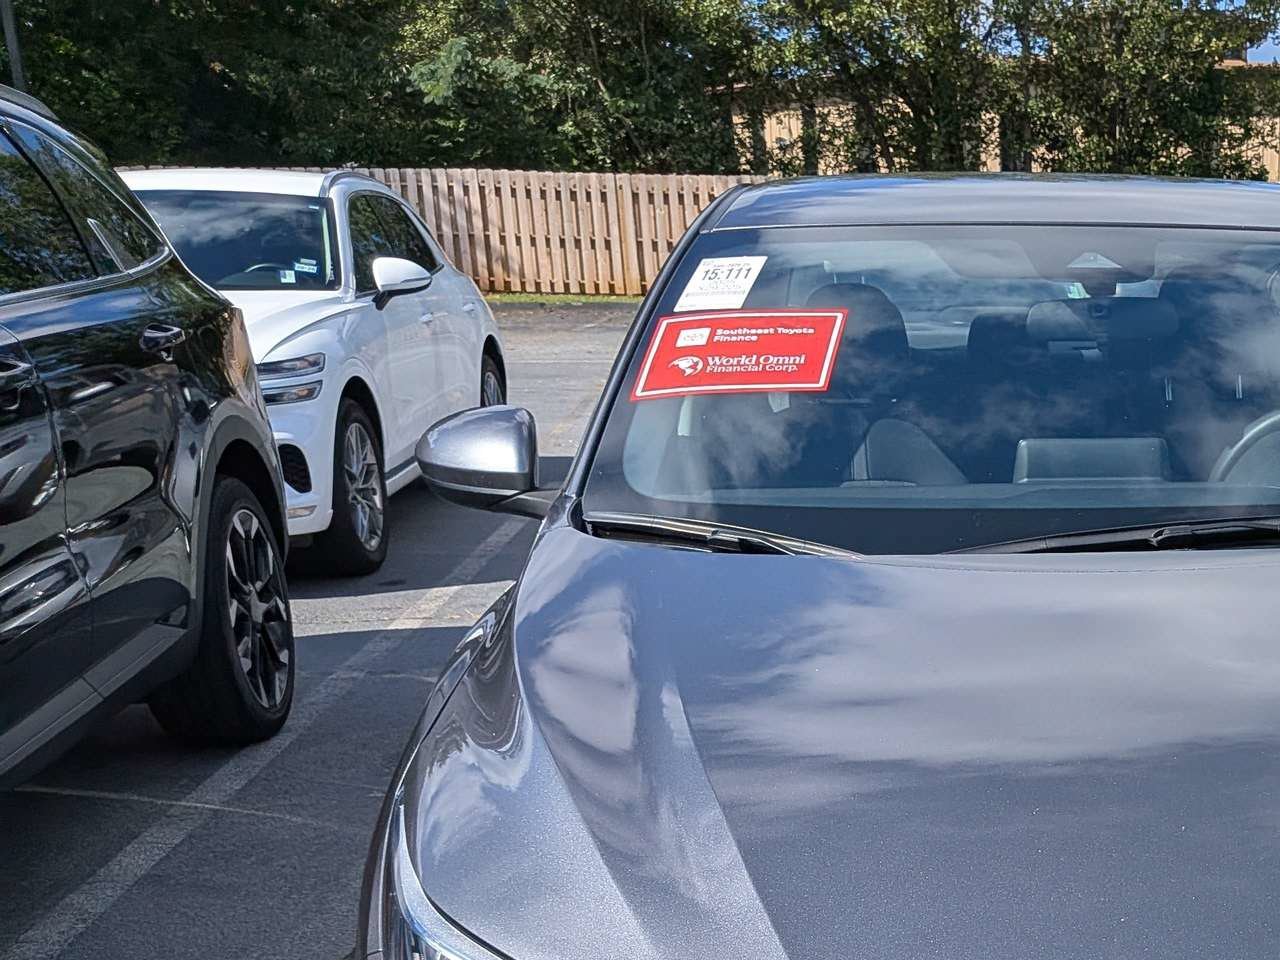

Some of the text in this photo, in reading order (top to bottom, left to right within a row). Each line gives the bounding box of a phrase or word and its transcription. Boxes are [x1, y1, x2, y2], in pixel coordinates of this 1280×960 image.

[716, 327, 815, 336] Southeast Toyota
[707, 354, 806, 366] World Omni
[706, 363, 798, 373] Financial Corp.
